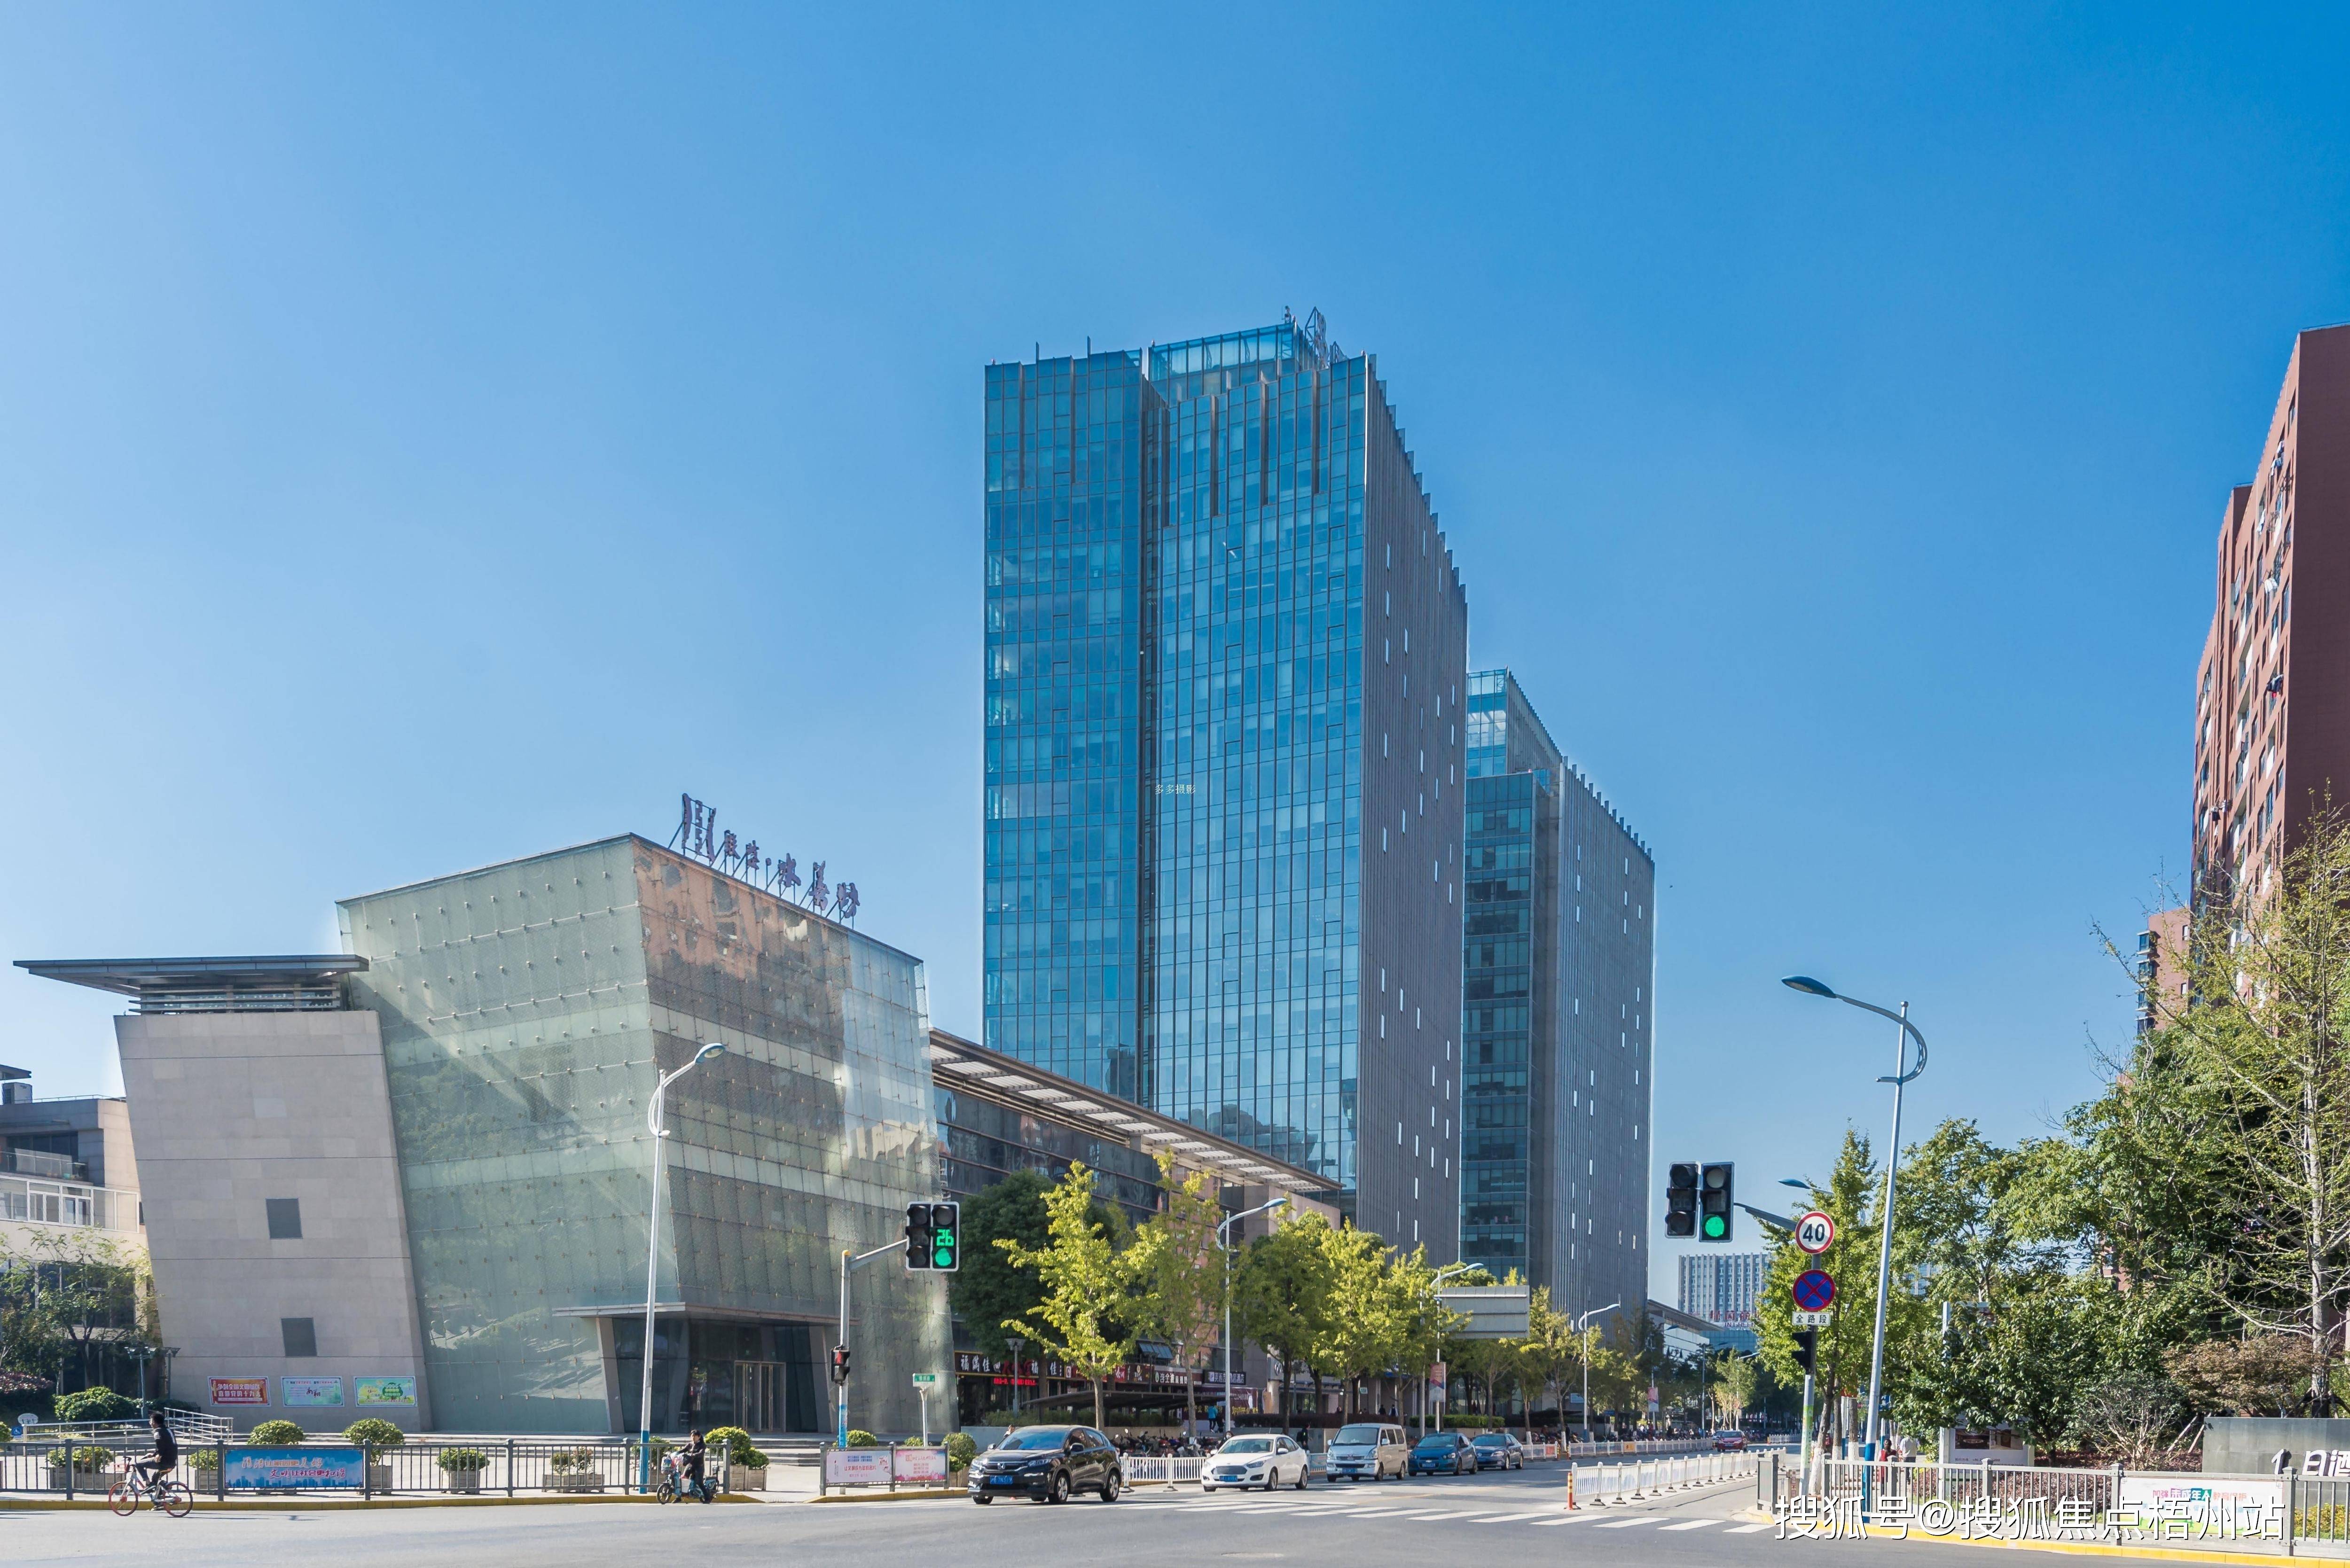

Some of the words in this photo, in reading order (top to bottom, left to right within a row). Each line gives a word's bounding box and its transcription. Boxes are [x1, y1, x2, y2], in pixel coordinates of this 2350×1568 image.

[936, 1229, 954, 1247] 26
[1802, 1223, 1825, 1243] 40
[1796, 1314, 1827, 1324] 全路段
